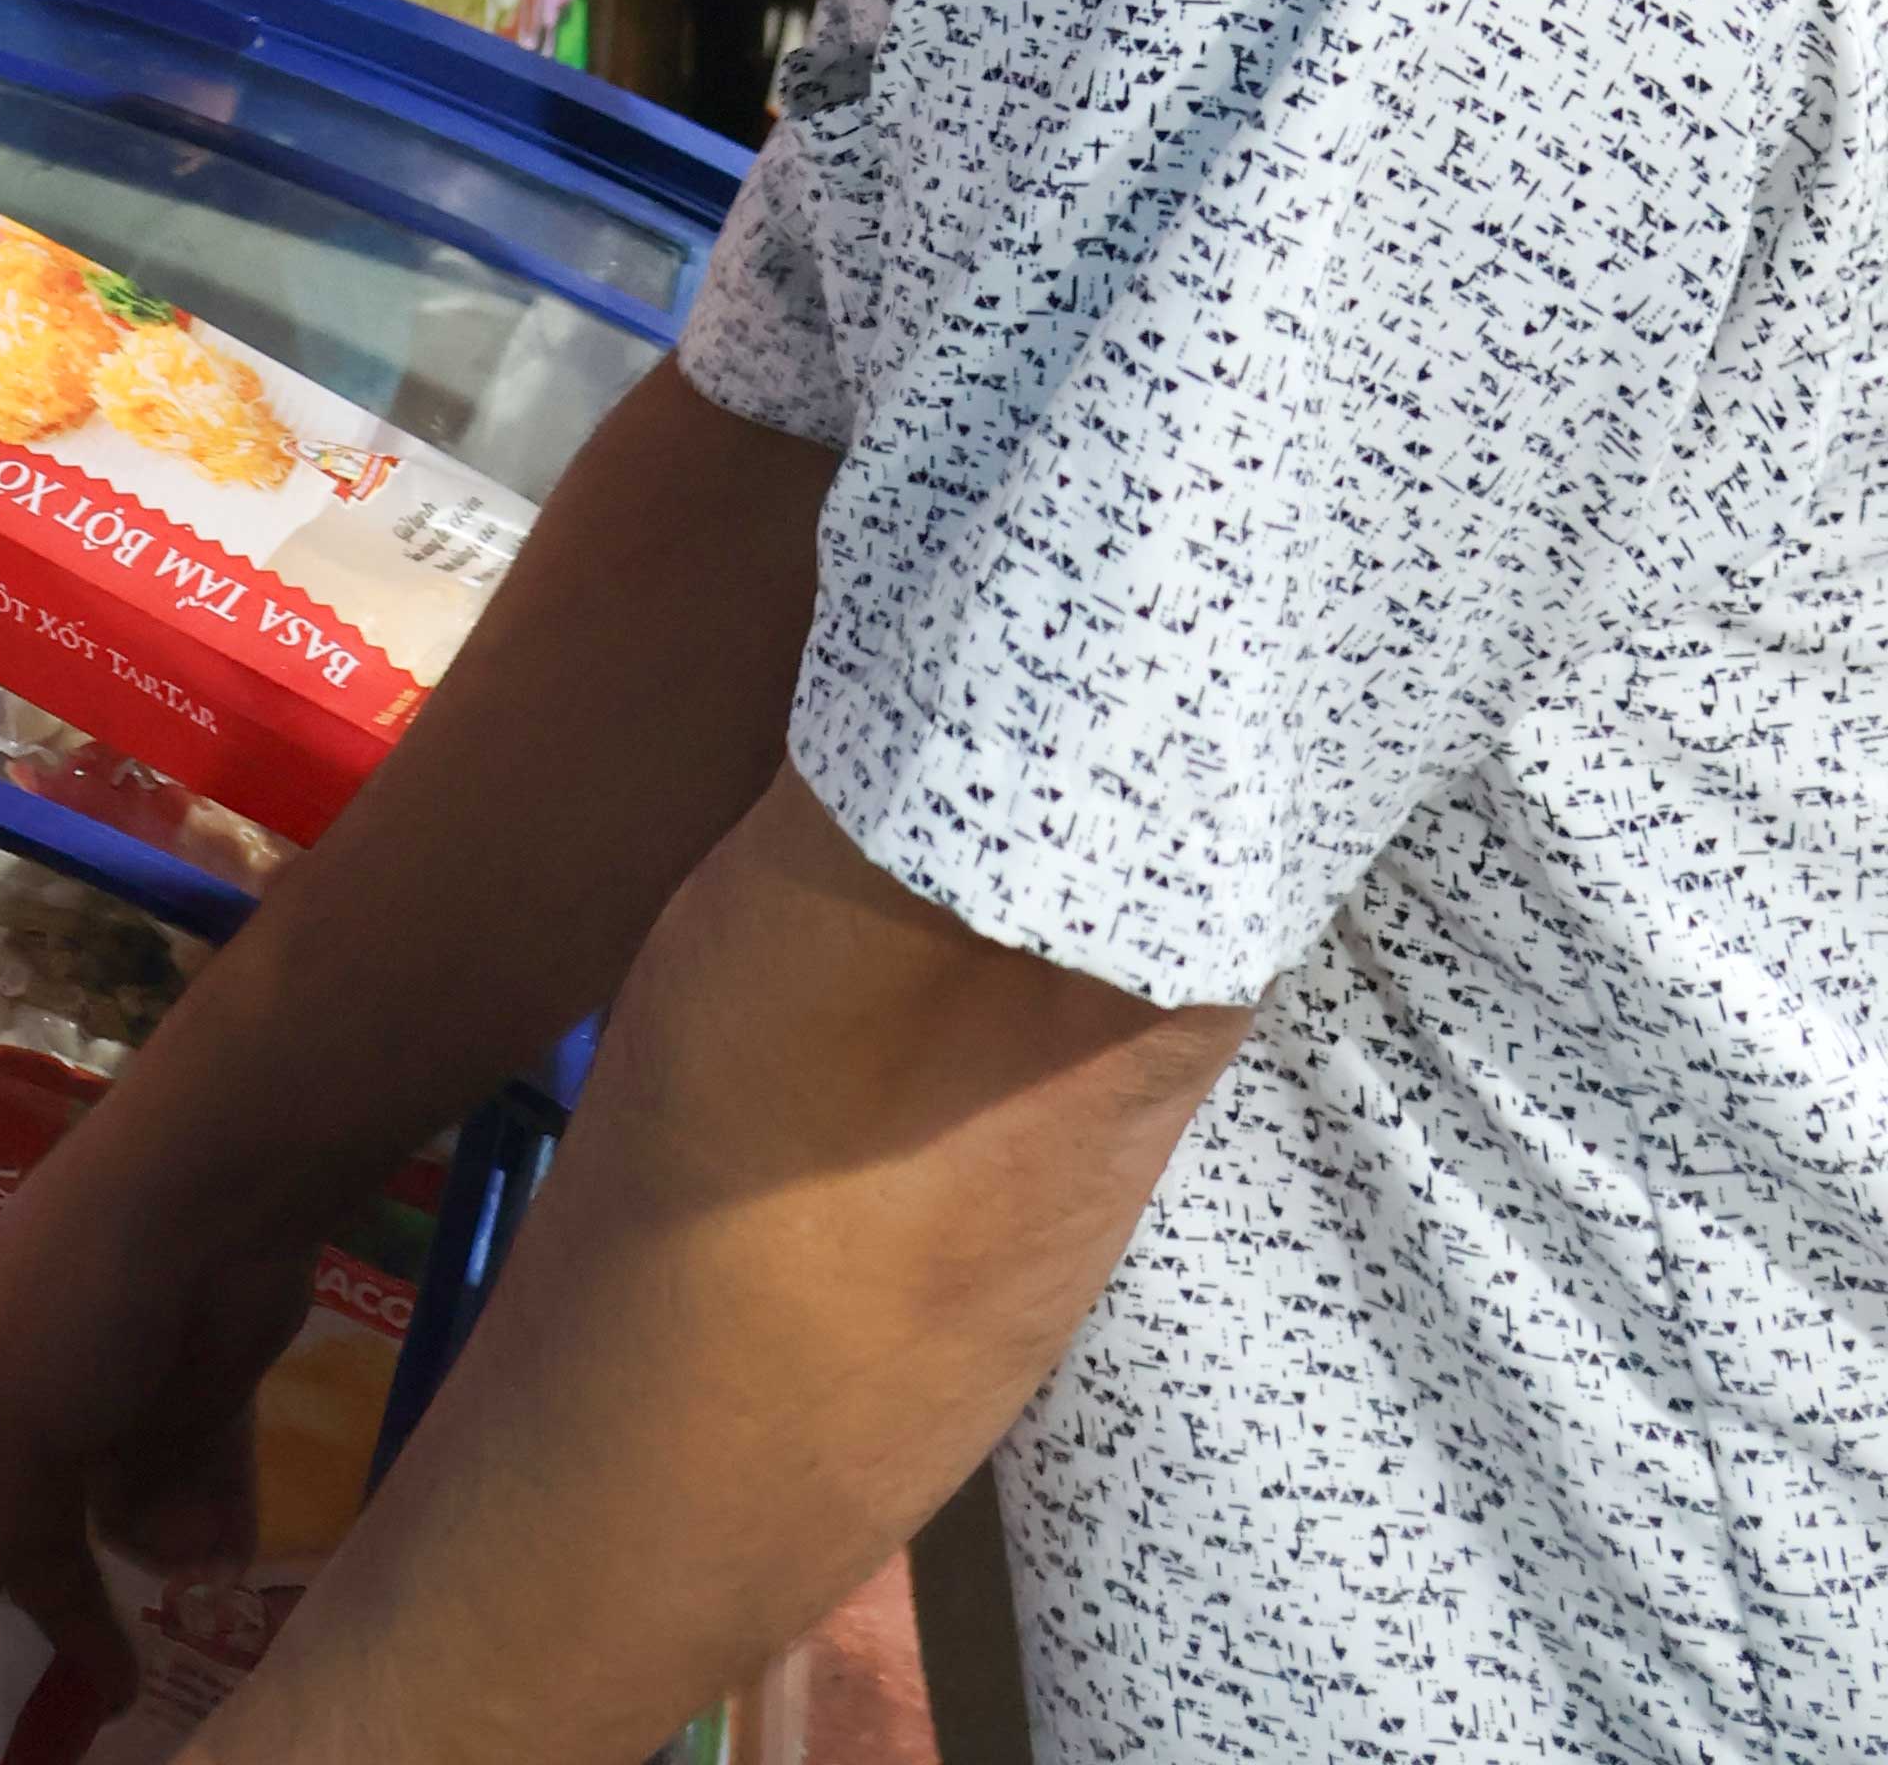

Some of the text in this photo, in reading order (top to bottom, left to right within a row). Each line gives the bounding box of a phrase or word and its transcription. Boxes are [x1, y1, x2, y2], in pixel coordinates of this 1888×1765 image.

[55, 497, 156, 569] BỘT
[155, 546, 249, 623] TẨM
[34, 608, 99, 661] XỐT
[106, 647, 219, 735] TARTAR
[259, 598, 361, 690] BASA
